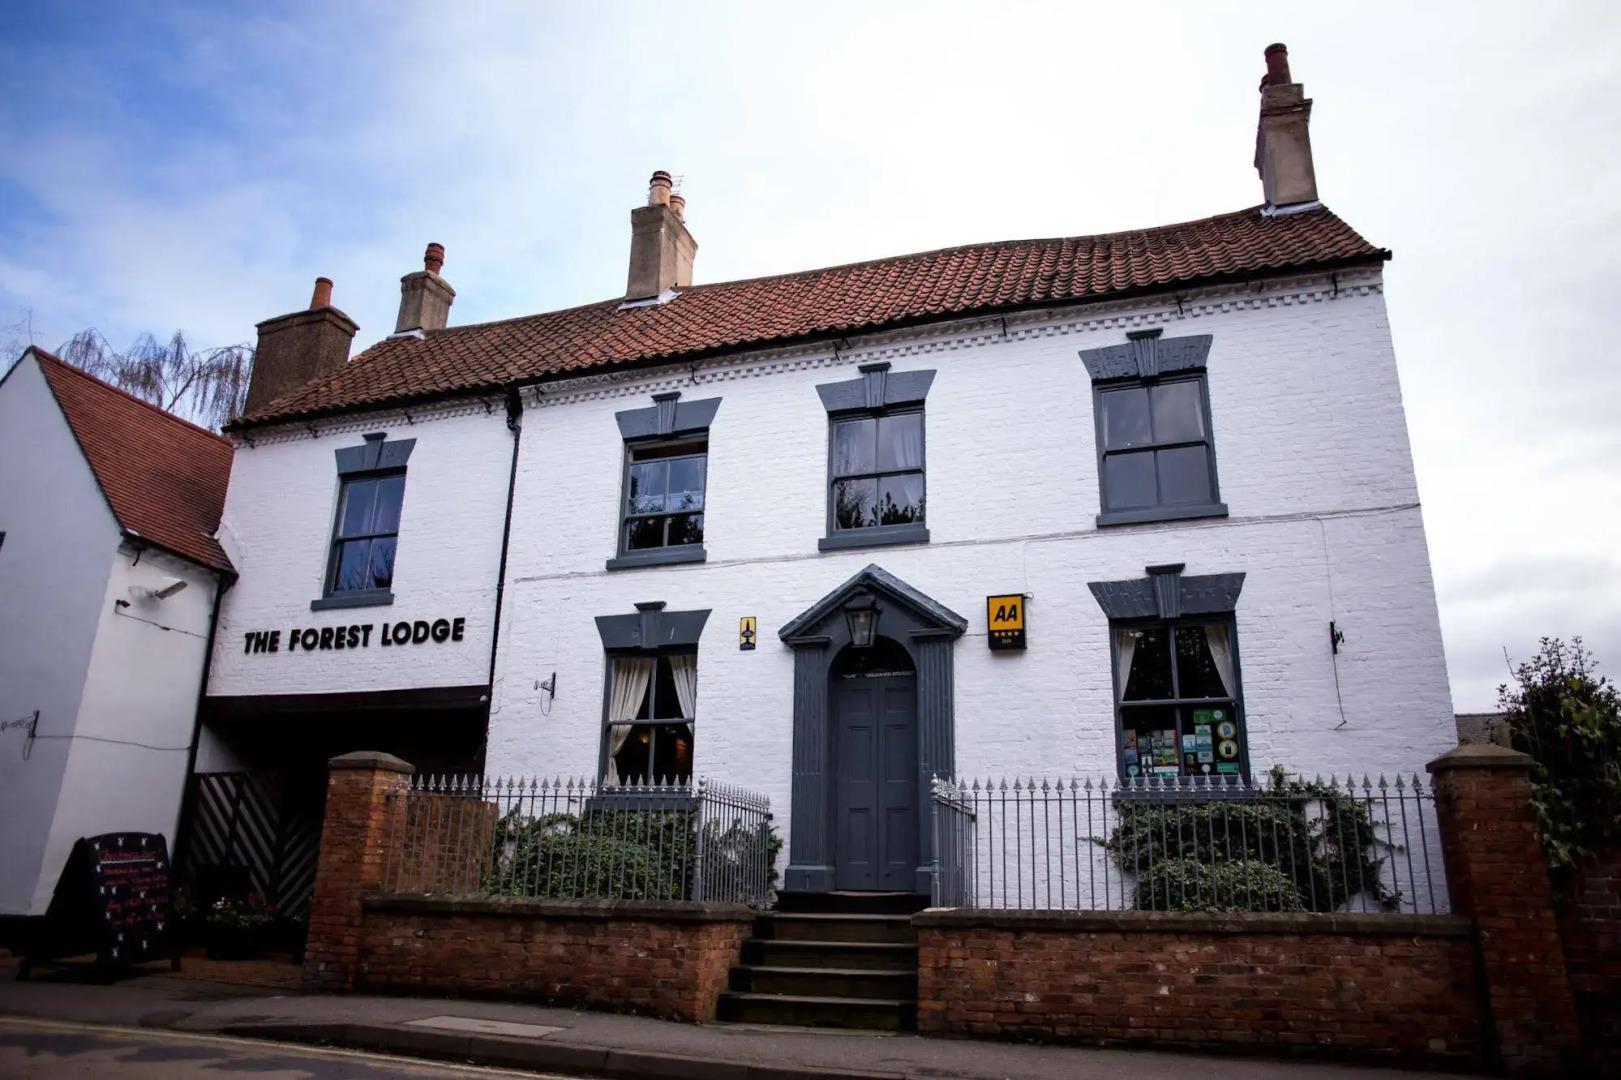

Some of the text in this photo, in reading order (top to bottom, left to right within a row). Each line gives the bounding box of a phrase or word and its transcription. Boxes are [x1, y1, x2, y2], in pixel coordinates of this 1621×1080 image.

[994, 604, 1018, 622] AA
[244, 617, 466, 654] THE FOREST LODGE
